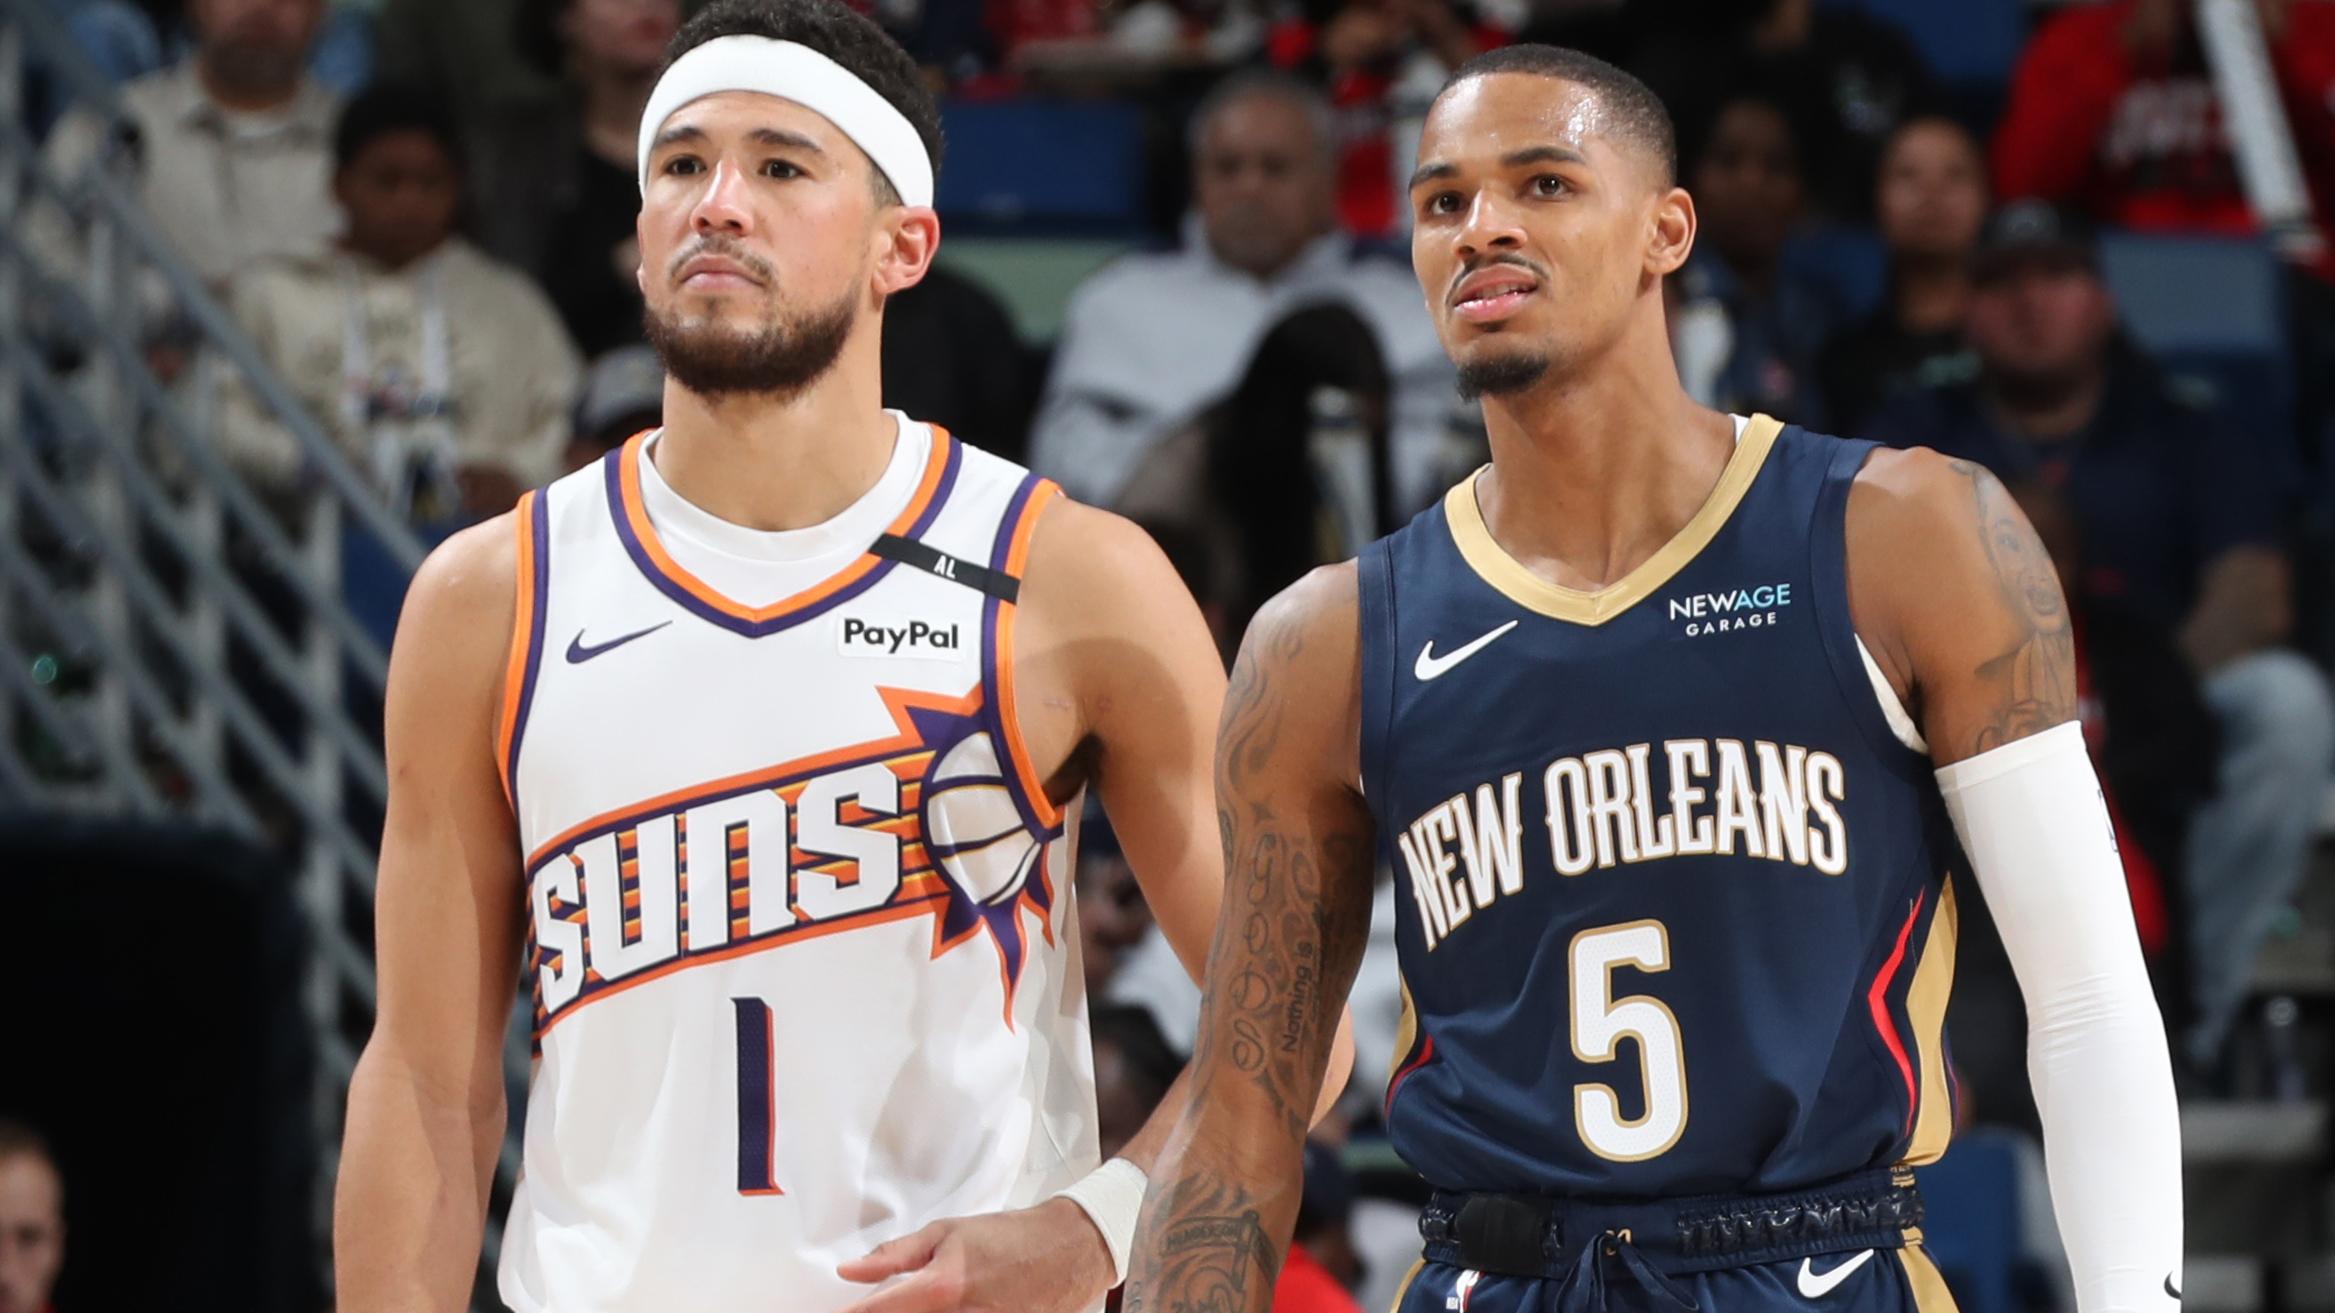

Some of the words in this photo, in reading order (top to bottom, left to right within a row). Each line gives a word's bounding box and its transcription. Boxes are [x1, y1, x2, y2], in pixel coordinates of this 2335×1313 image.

[844, 618, 958, 654] PayPal
[933, 554, 957, 580] AL
[1685, 611, 1777, 637] GARAGE
[531, 762, 902, 1014] SUNS
[1399, 771, 1524, 953] NEW
[1543, 738, 1848, 876] ORLEANS
[1281, 965, 1313, 1052] Nothing
[1568, 918, 1689, 1163] 5
[730, 996, 785, 1196] 1
